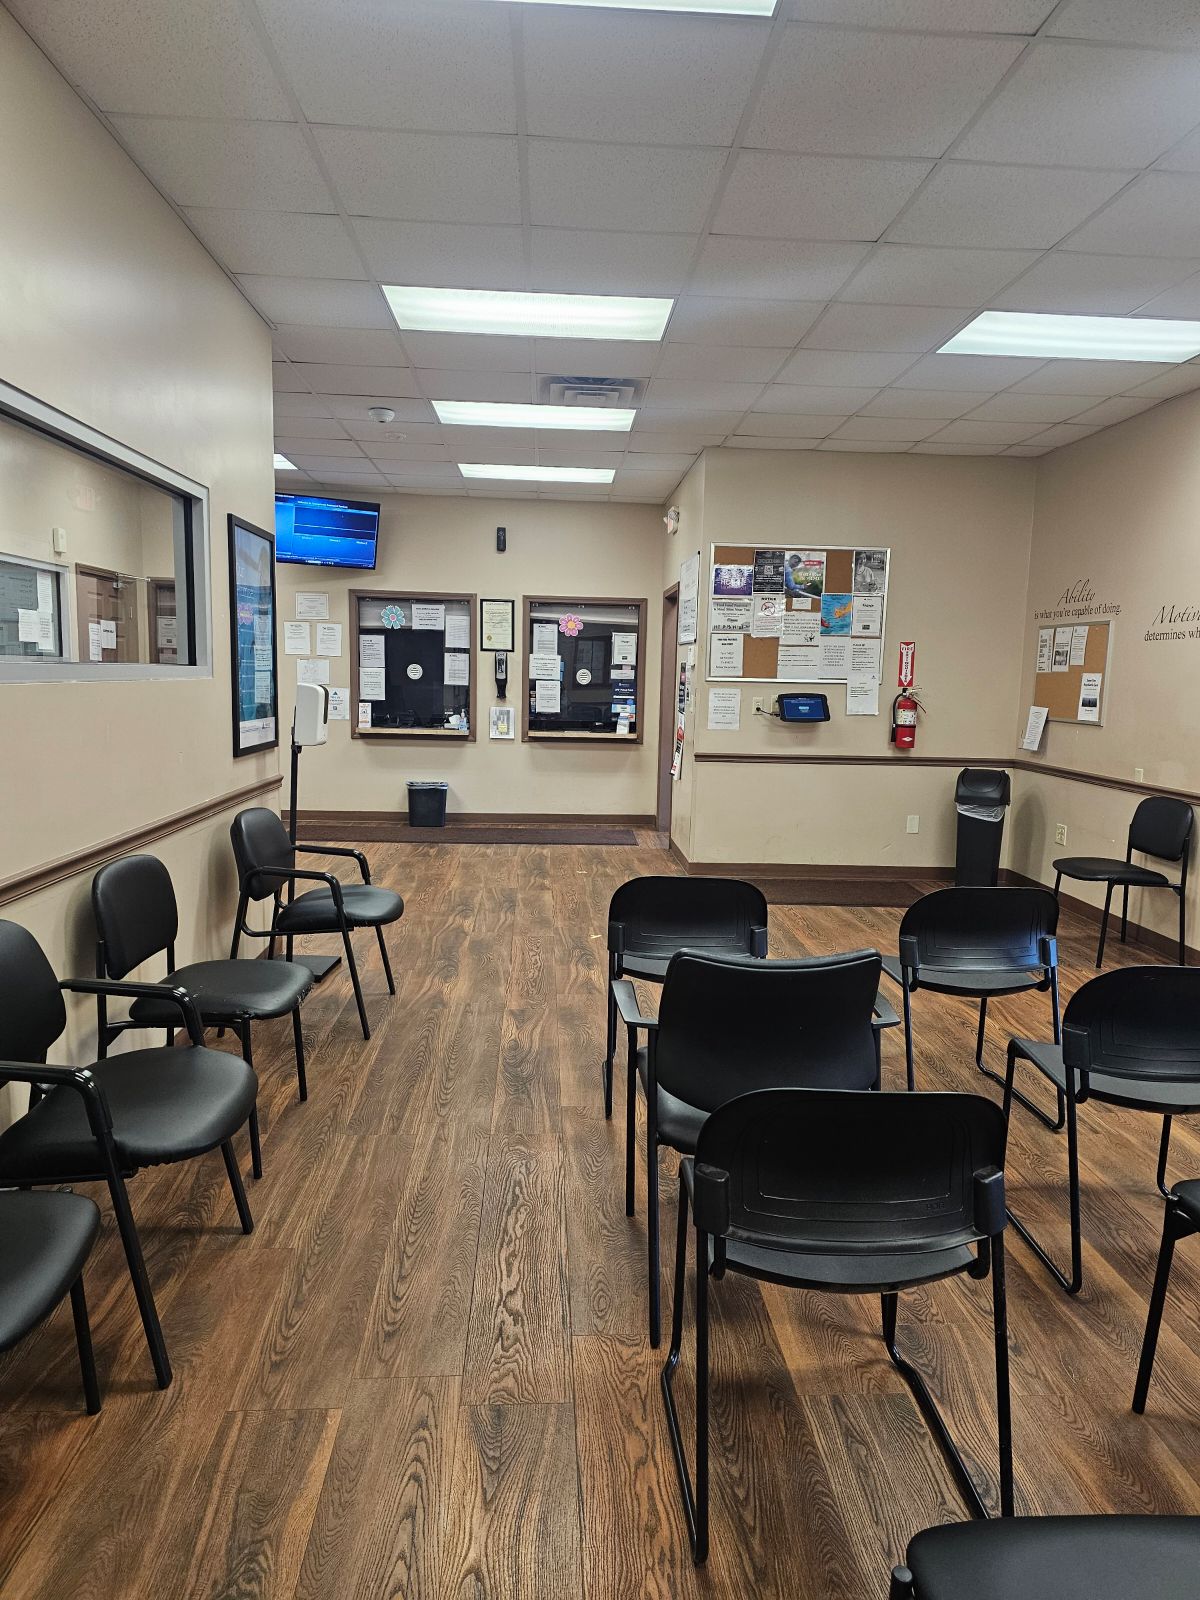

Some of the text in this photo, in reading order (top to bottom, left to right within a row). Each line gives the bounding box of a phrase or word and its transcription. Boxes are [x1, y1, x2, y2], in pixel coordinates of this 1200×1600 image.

[1057, 578, 1096, 606] Ability
[1034, 602, 1122, 620] is what you're capable of doing.
[1144, 628, 1186, 641] determines
